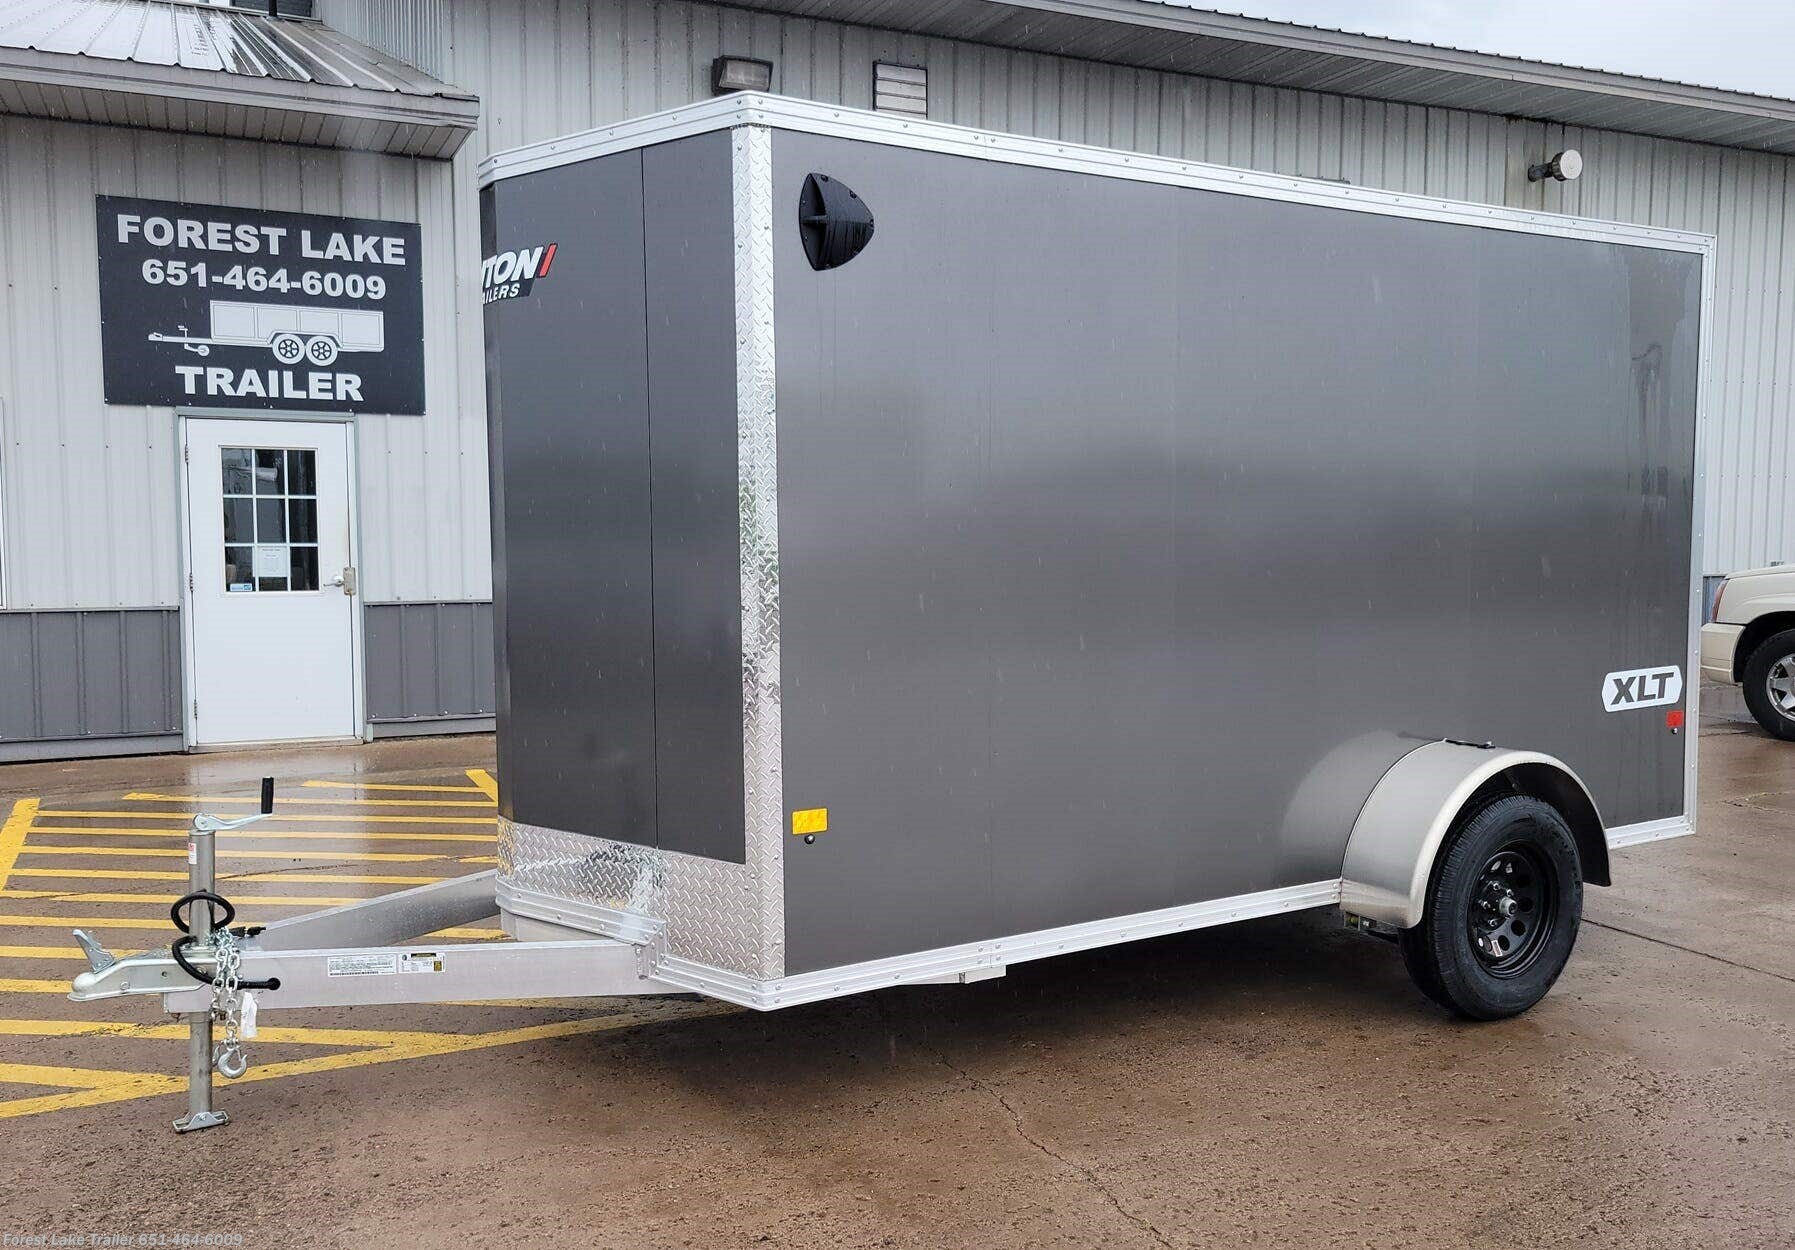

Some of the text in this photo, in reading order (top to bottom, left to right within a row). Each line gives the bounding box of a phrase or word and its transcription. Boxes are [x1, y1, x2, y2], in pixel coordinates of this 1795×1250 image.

[117, 214, 406, 266] FOREST LAKE
[141, 258, 386, 300] 651-464-6009
[175, 365, 364, 402] TRAILER
[1610, 671, 1675, 706] XLT
